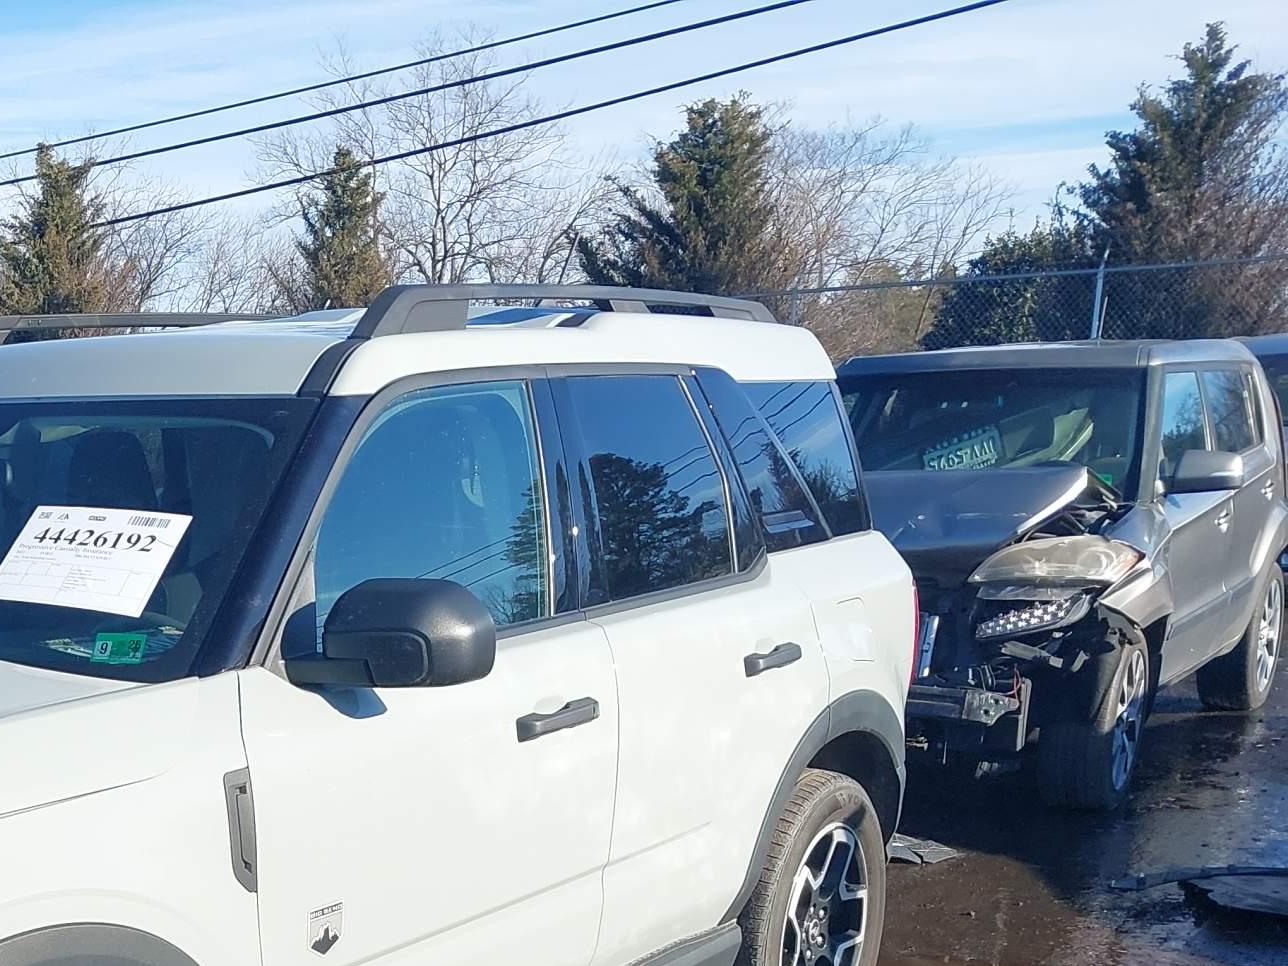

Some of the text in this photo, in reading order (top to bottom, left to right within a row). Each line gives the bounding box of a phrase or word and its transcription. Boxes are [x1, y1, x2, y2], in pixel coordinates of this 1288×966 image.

[33, 527, 157, 552] 44426192
[100, 642, 109, 655] 9
[310, 902, 343, 919] BIG BEND
